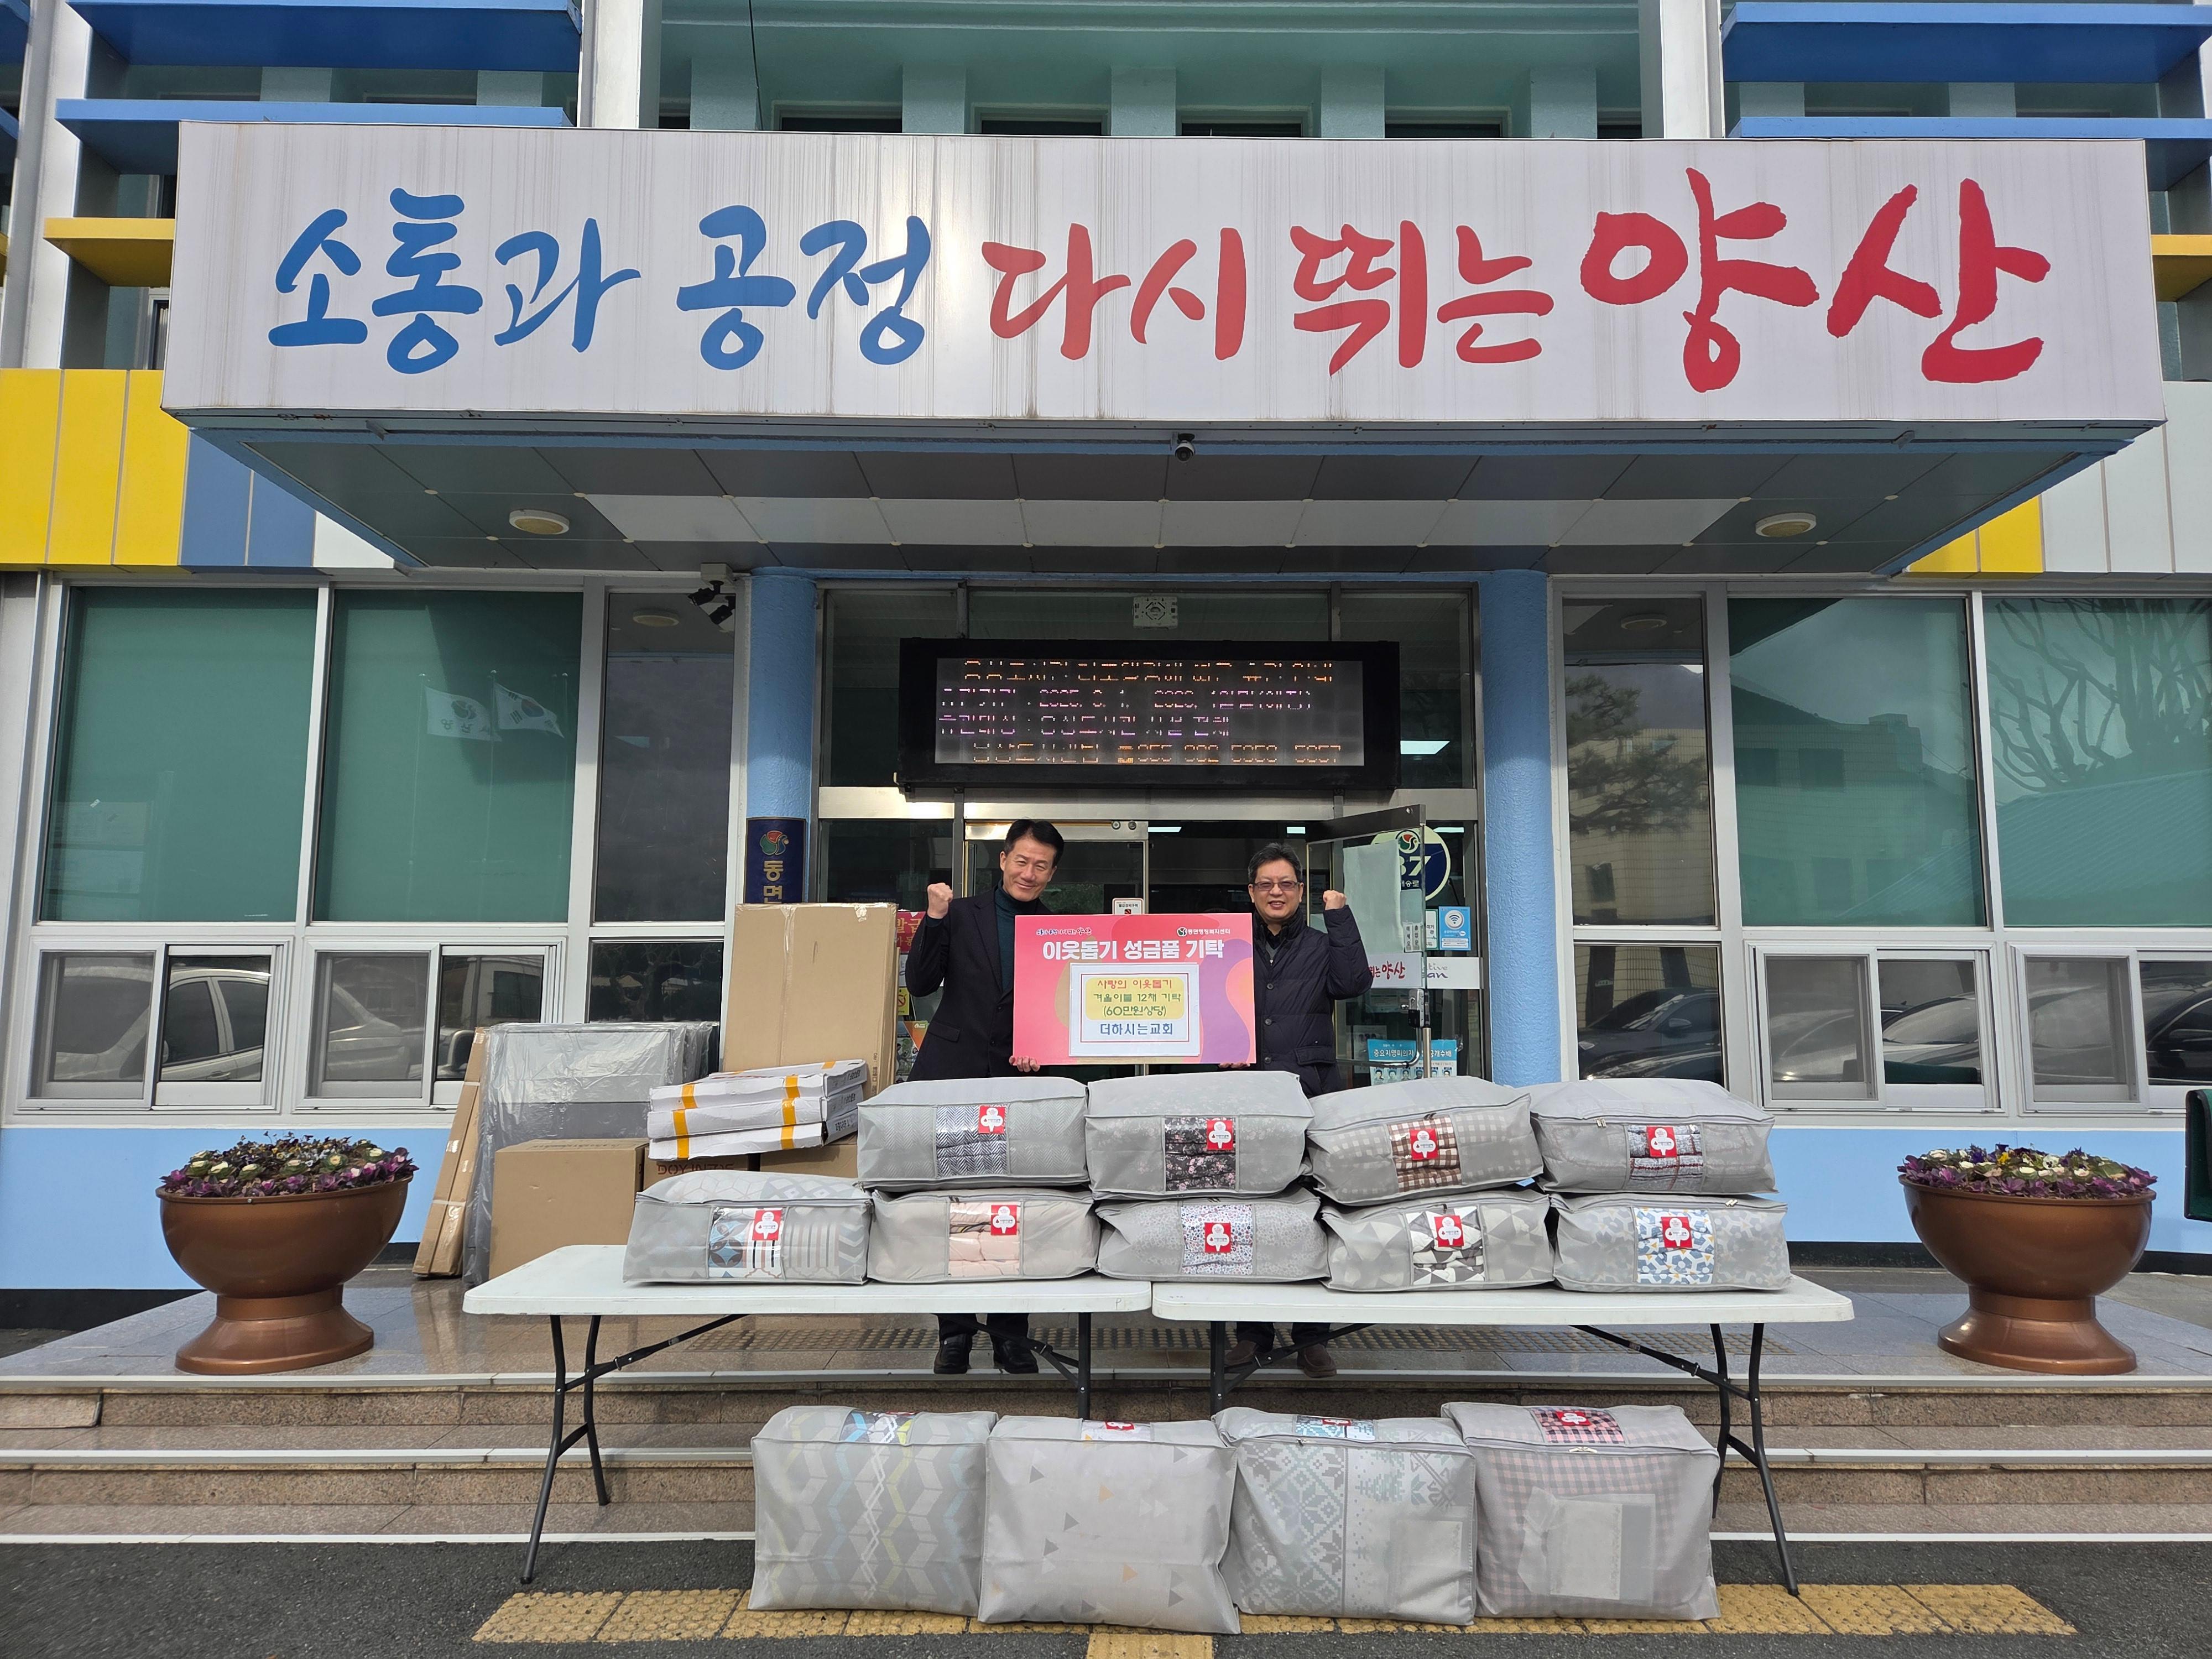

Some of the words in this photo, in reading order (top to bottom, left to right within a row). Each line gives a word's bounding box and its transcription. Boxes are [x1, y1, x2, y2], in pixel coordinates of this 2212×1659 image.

[269, 188, 640, 374] 소통과
[677, 205, 930, 369] 공정
[983, 223, 1246, 360] 다시
[1291, 220, 1553, 376] 뛰는
[1580, 168, 2051, 393] 양산
[1043, 941, 1117, 960] 이웃돕기
[1123, 940, 1180, 959] 성금품
[1186, 940, 1224, 958] 기탁
[1382, 961, 1406, 979] 양산
[1098, 980, 1126, 989] 사랑의
[1133, 979, 1172, 989] 이웃돕기
[1093, 993, 1132, 1002] 겨울이불
[1138, 993, 1157, 1002] 12채
[1161, 993, 1181, 1002] 기탁
[1104, 1005, 1166, 1017] (60만원상당)
[1100, 1023, 1173, 1035] 더하시는교회
